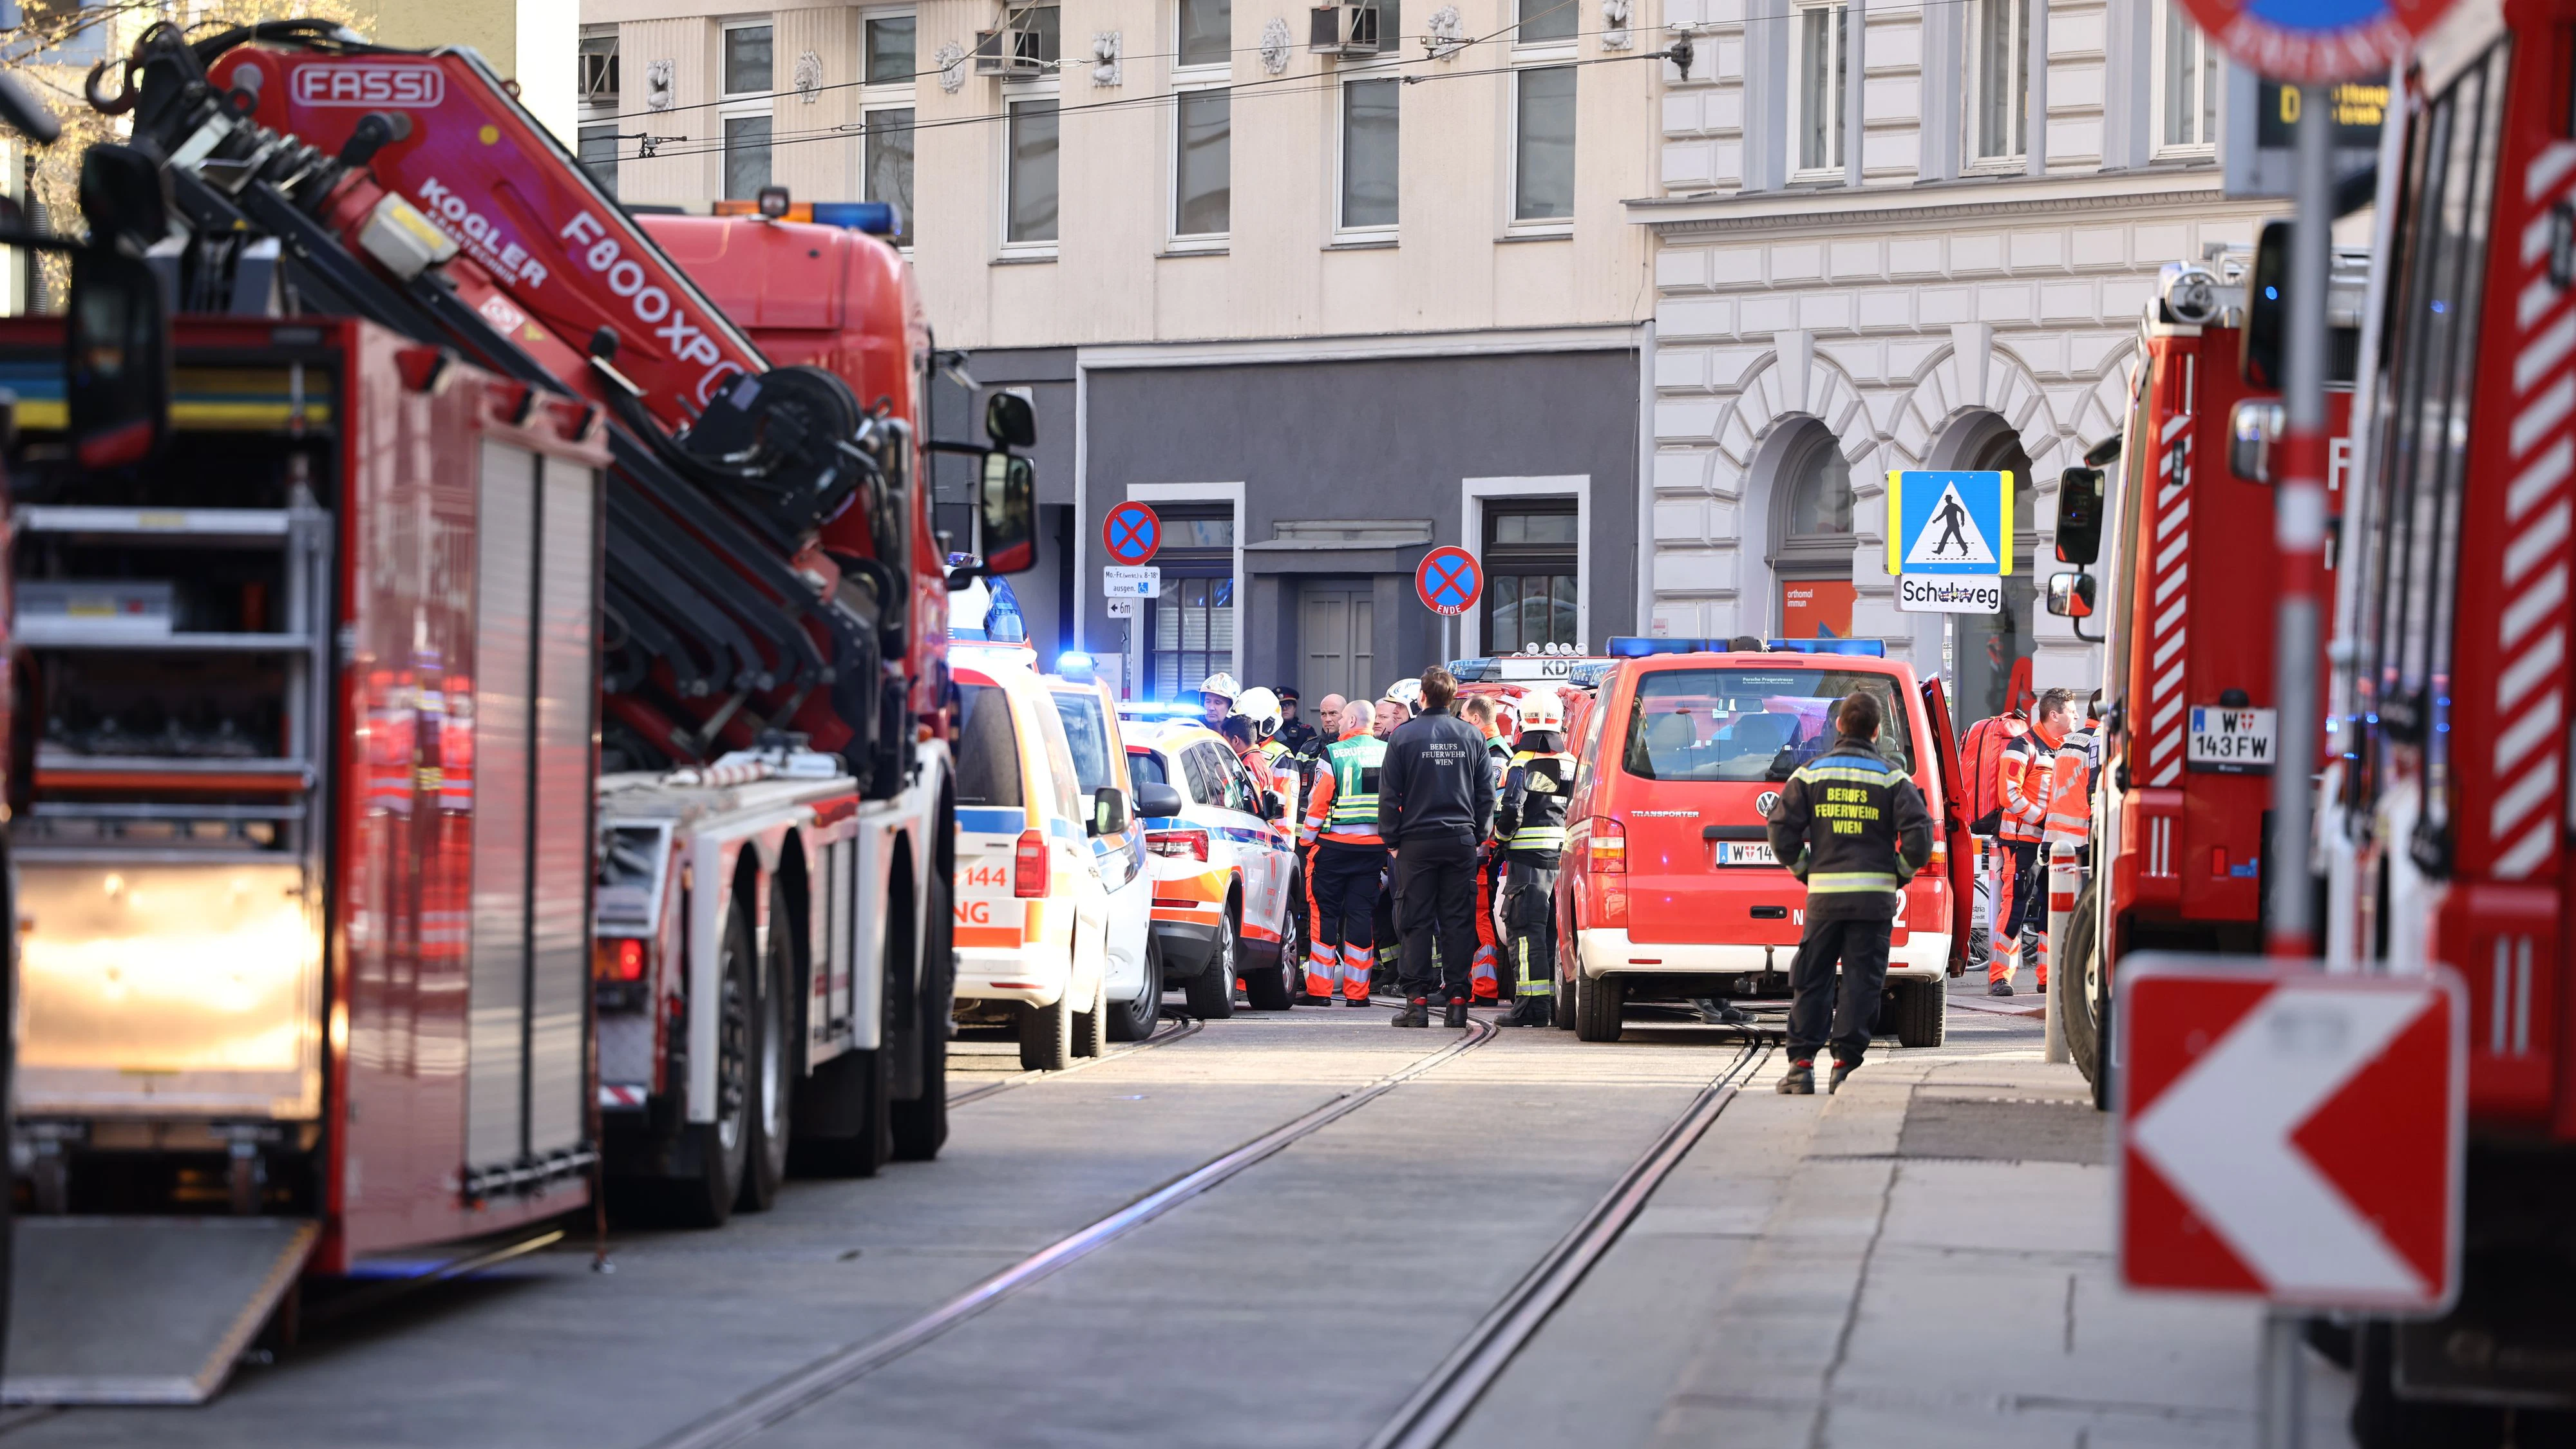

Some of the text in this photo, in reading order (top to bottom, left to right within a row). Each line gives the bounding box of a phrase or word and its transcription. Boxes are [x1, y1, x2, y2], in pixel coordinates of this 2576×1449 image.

[304, 71, 433, 100] FASSI
[418, 176, 549, 289] KOGLER
[1787, 589, 1813, 598] orthomol
[1903, 580, 1998, 609] Schulweg
[1120, 602, 1131, 614] 6m
[1437, 605, 1461, 614] ENDE
[1787, 599, 1806, 607] immun
[2222, 712, 2238, 734] W
[2196, 735, 2267, 758] 143 FW
[1826, 788, 1868, 803] BERUFS
[1815, 803, 1879, 820] FEUERWEHR
[1832, 820, 1863, 834] WIEN
[1733, 846, 1772, 860] W 14
[965, 866, 1007, 887] 144
[954, 901, 989, 923] NG
